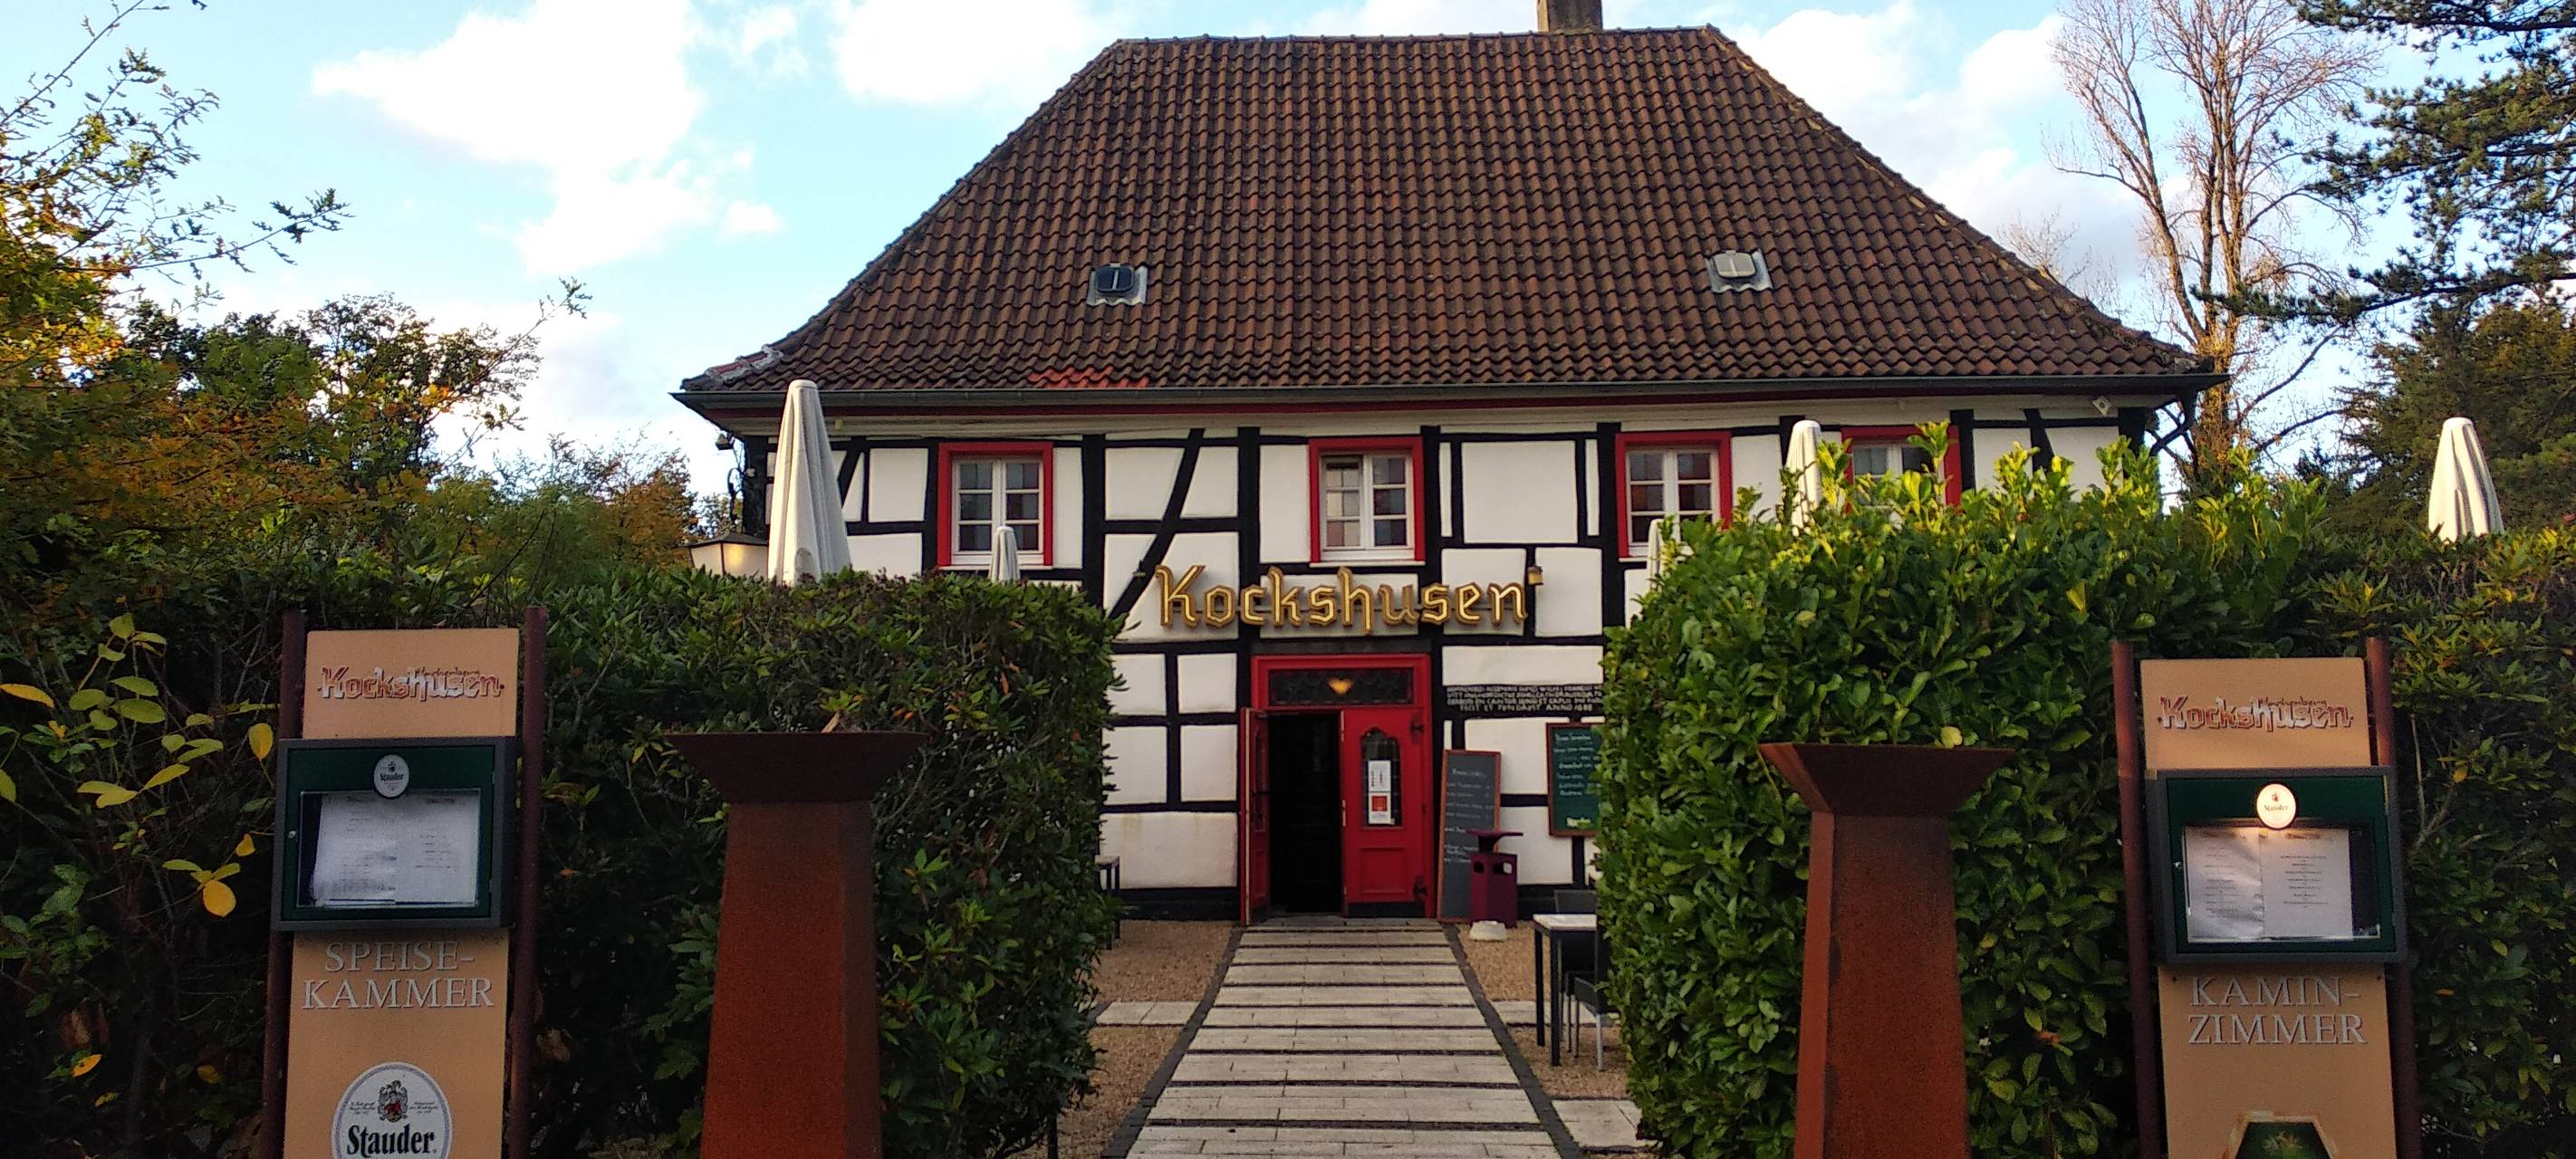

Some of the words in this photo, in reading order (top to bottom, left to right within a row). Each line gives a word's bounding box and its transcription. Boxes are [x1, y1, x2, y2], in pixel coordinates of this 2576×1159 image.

[1155, 564, 1528, 636] Kockshusen
[321, 666, 504, 702] Kockshusen
[2159, 695, 2352, 732] Kockshusen
[324, 941, 476, 972] SPEISE-
[303, 977, 495, 1010] KAMMER
[2190, 976, 2362, 1007] KAMIN-
[2187, 1013, 2369, 1045] ZIMMER
[346, 1123, 435, 1158] Stauder
